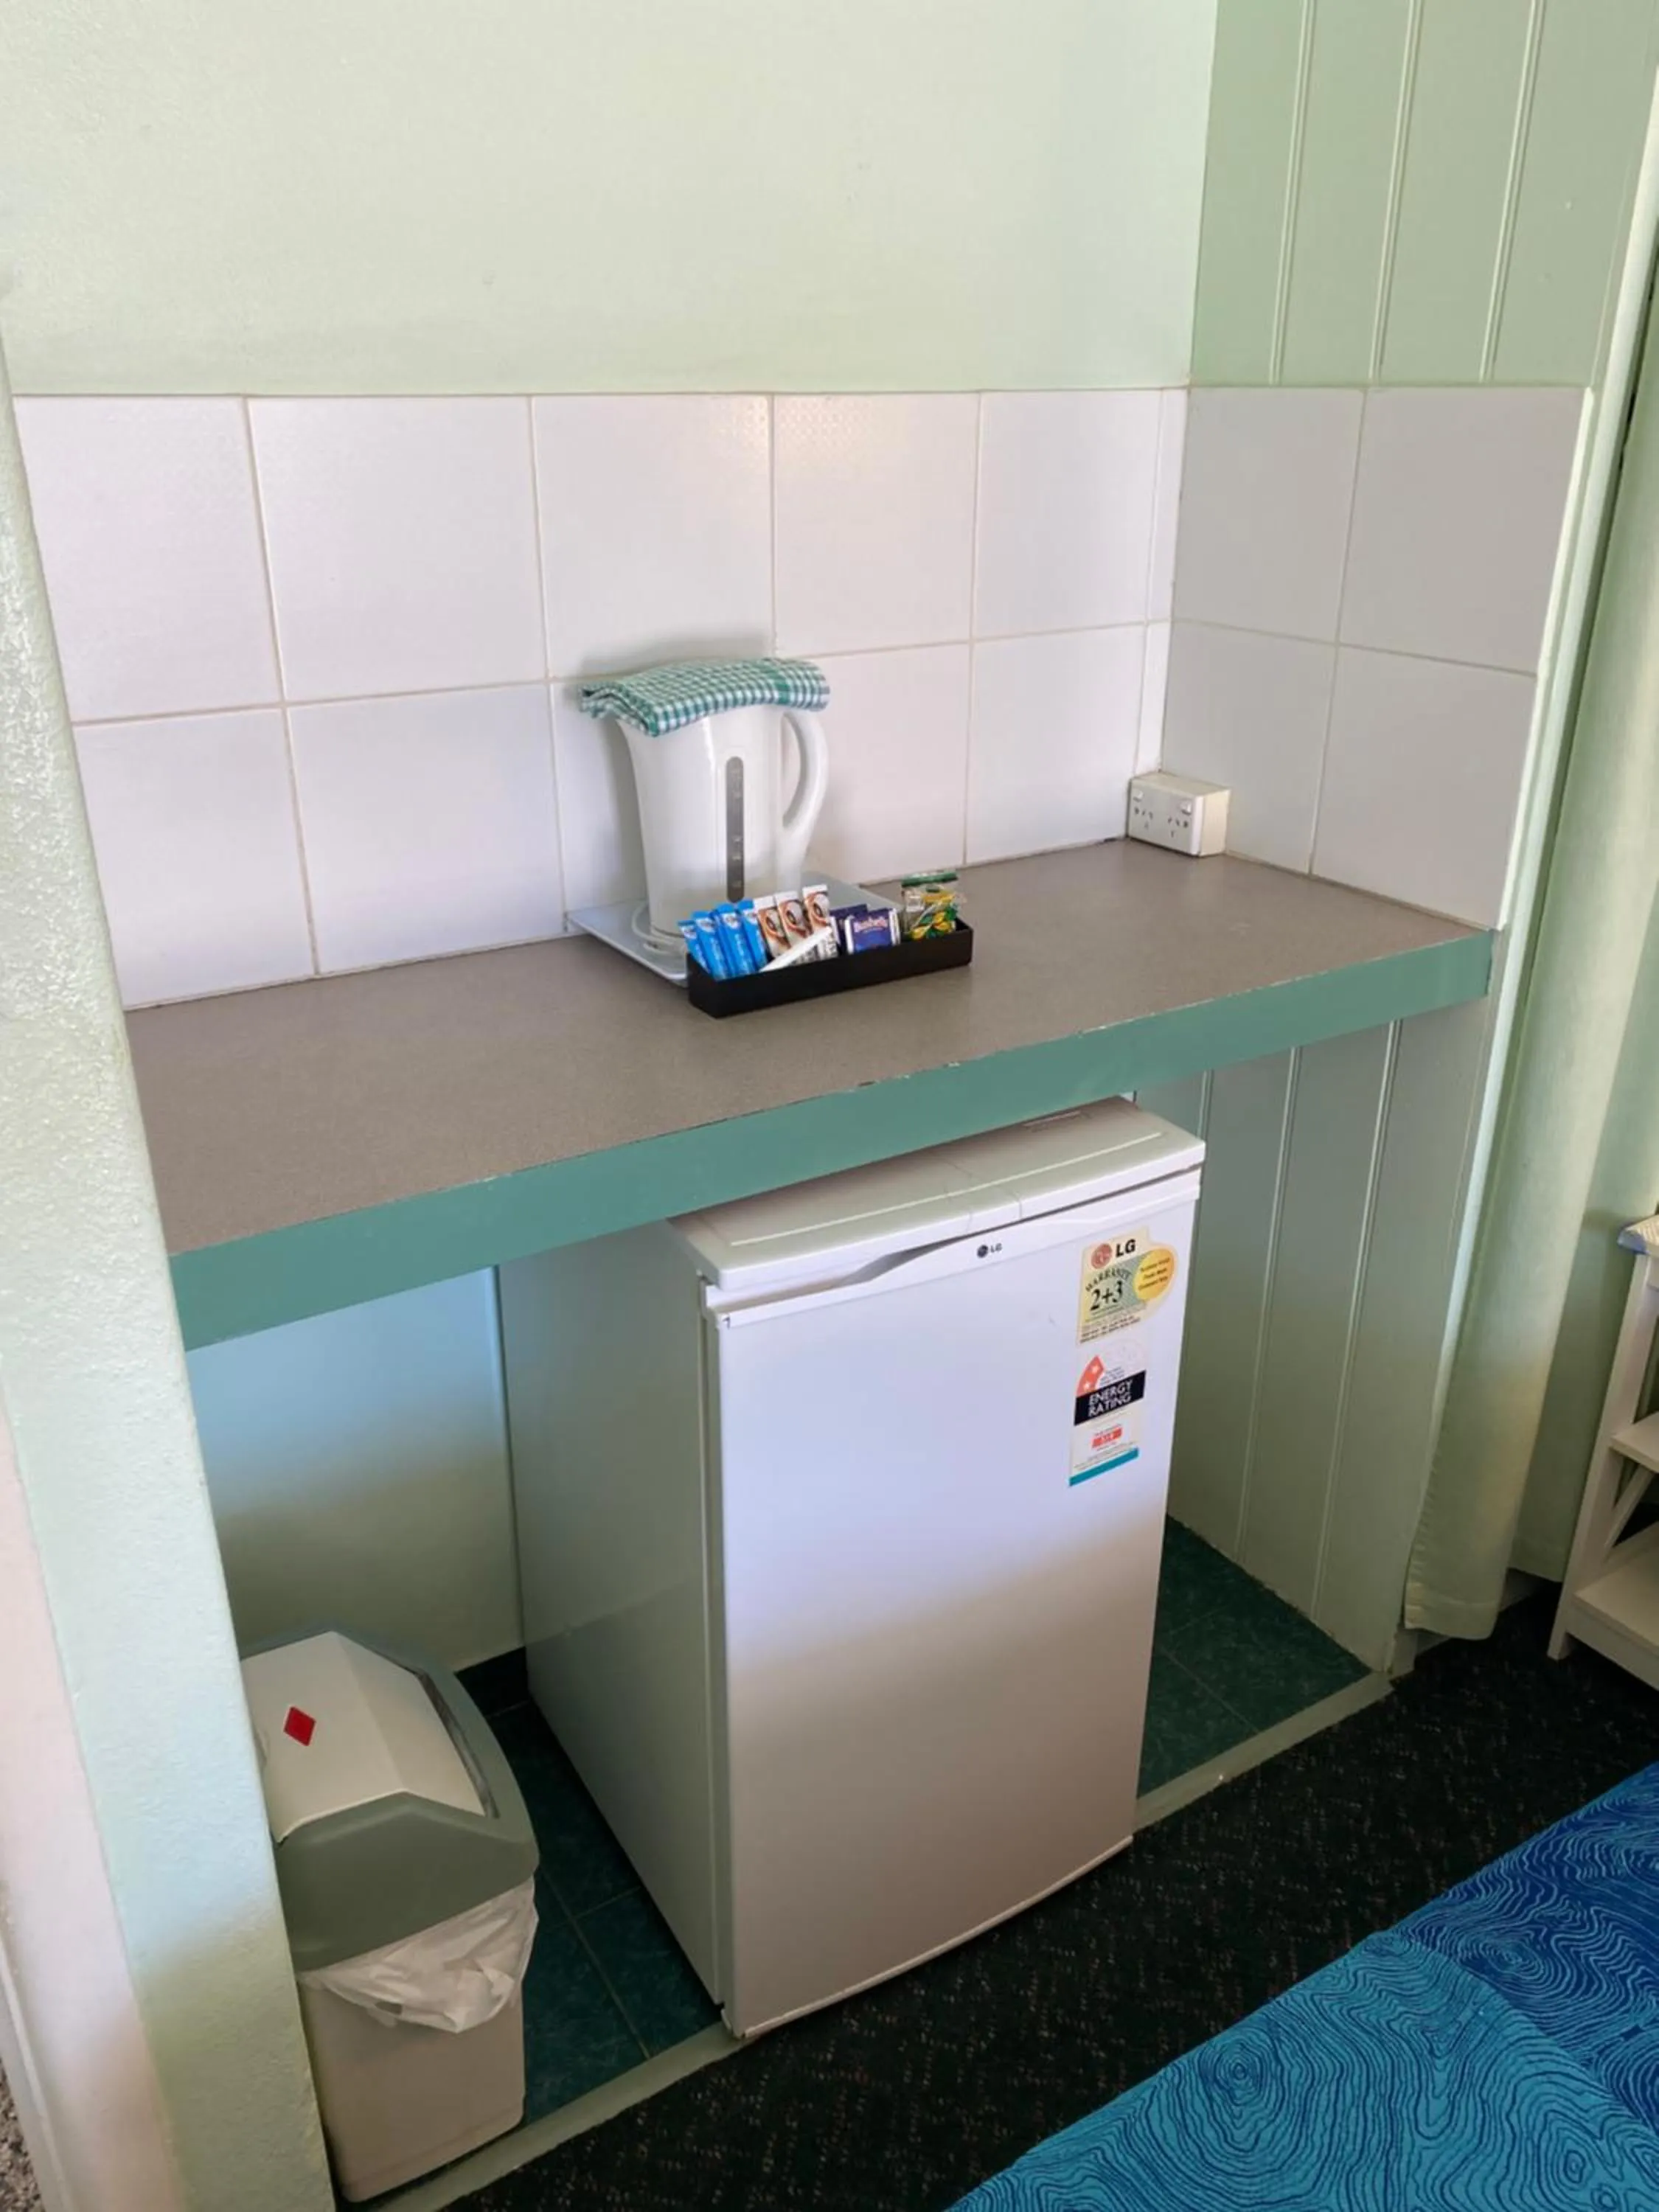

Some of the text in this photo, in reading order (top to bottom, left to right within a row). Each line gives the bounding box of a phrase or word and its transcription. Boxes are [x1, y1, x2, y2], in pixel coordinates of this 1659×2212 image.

[990, 1242, 1003, 1253] LG
[1116, 1239, 1136, 1258] LG
[1085, 1267, 1133, 1292] WARRANTY
[1090, 1280, 1124, 1311] 2+3
[1088, 1380, 1133, 1406] ENERGY
[1088, 1394, 1132, 1418] RATING
